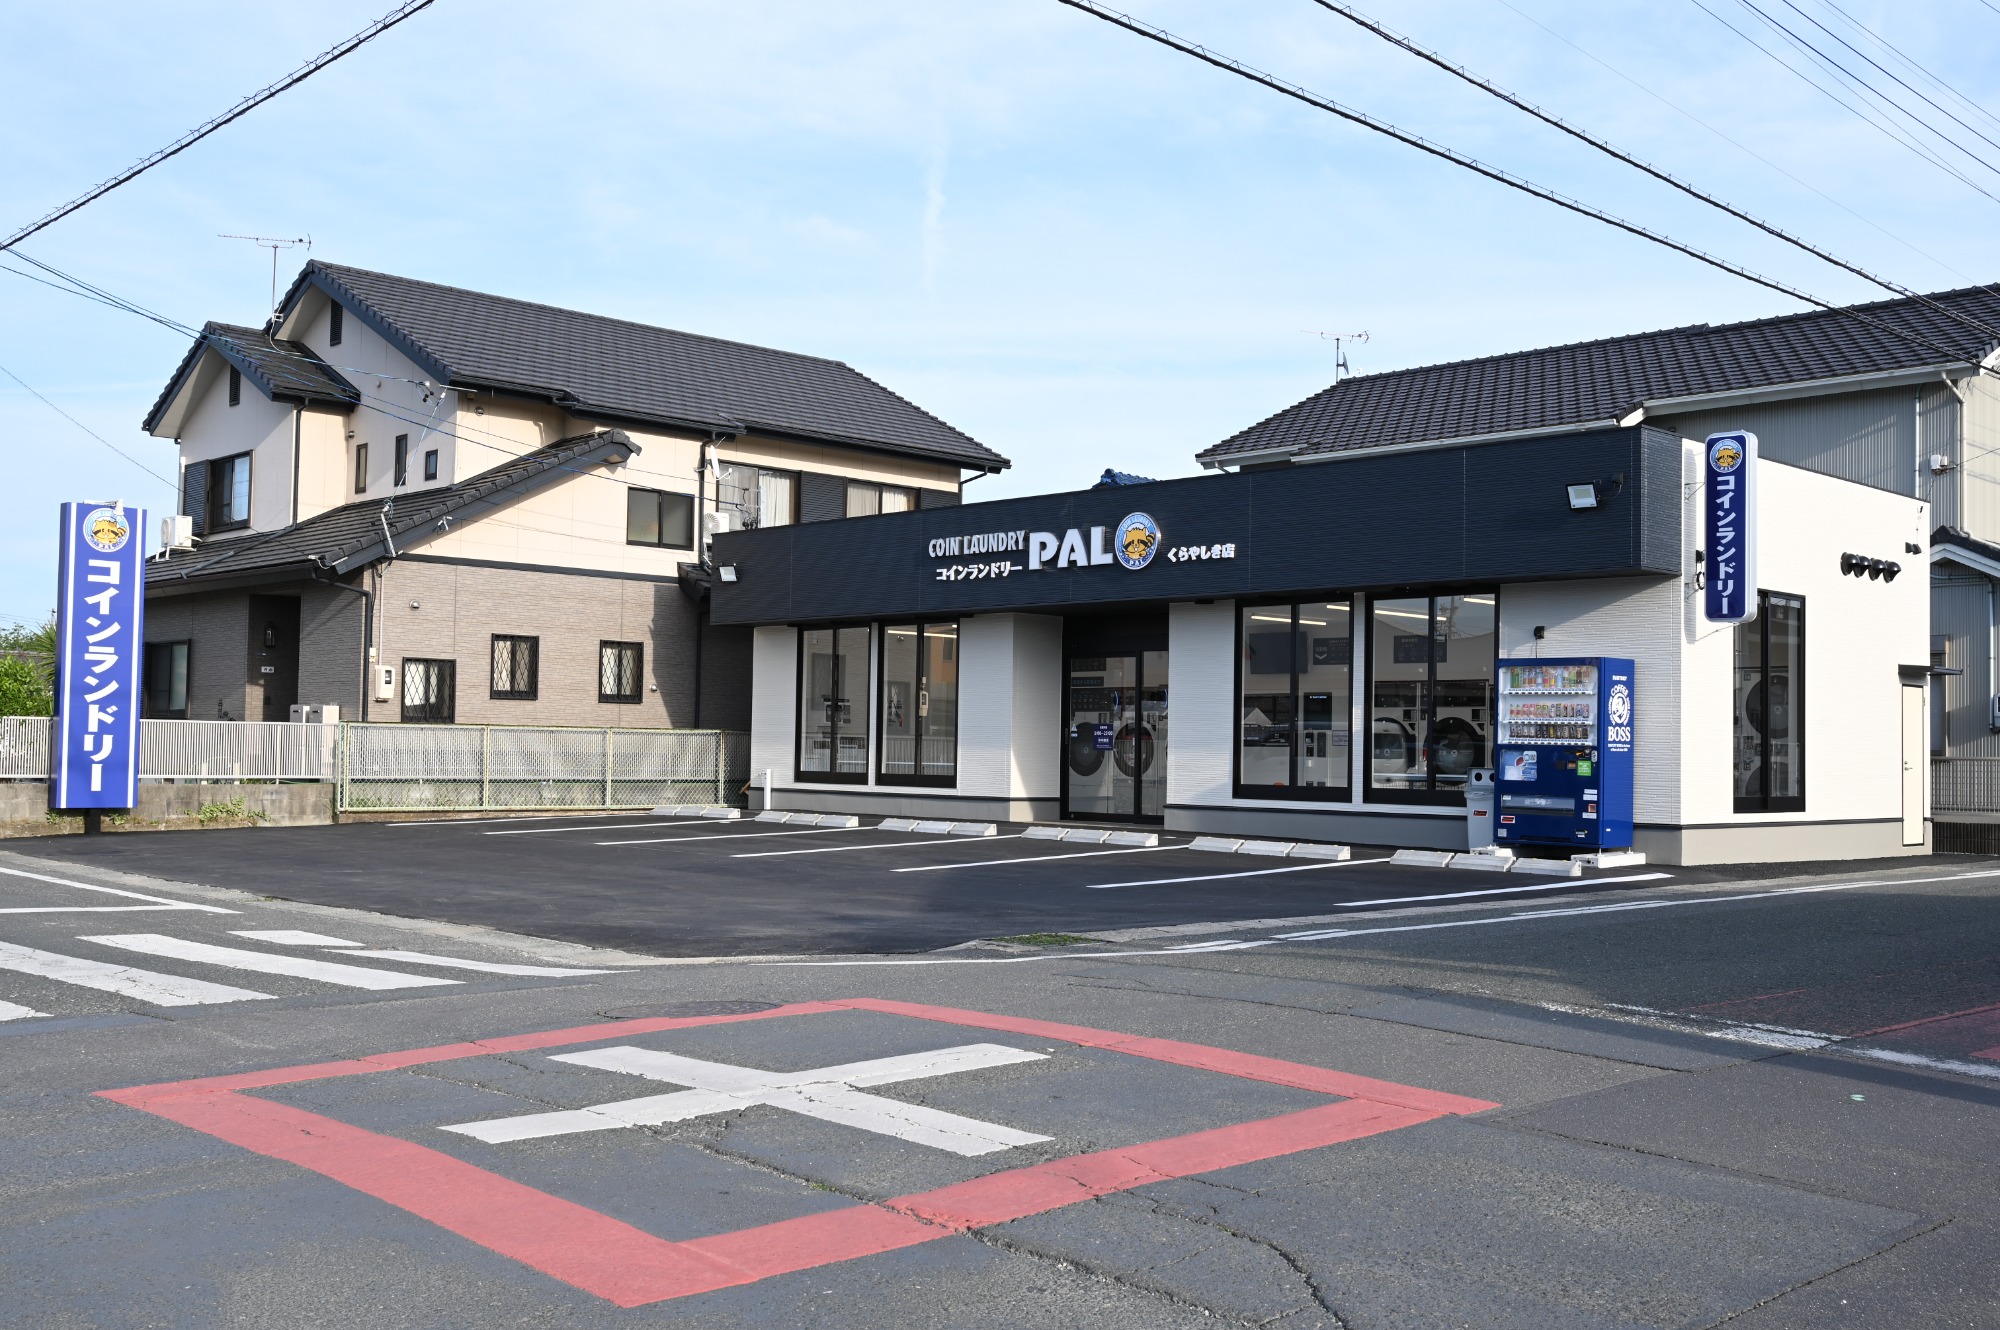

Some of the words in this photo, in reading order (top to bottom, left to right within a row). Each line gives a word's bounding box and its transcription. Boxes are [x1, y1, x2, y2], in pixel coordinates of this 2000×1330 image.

[929, 537, 961, 557] COIN
[963, 531, 1025, 555] LAUNDRY
[1028, 526, 1113, 570] PAL
[1167, 543, 1235, 562] くらやしき店
[1715, 475, 1736, 615] コインランドリー
[936, 561, 1022, 580] コインランドリー
[1129, 559, 1144, 567] PAL
[84, 559, 121, 791] コインランドリー
[1610, 684, 1629, 697] COFFEE
[1607, 726, 1631, 741] BOSS
